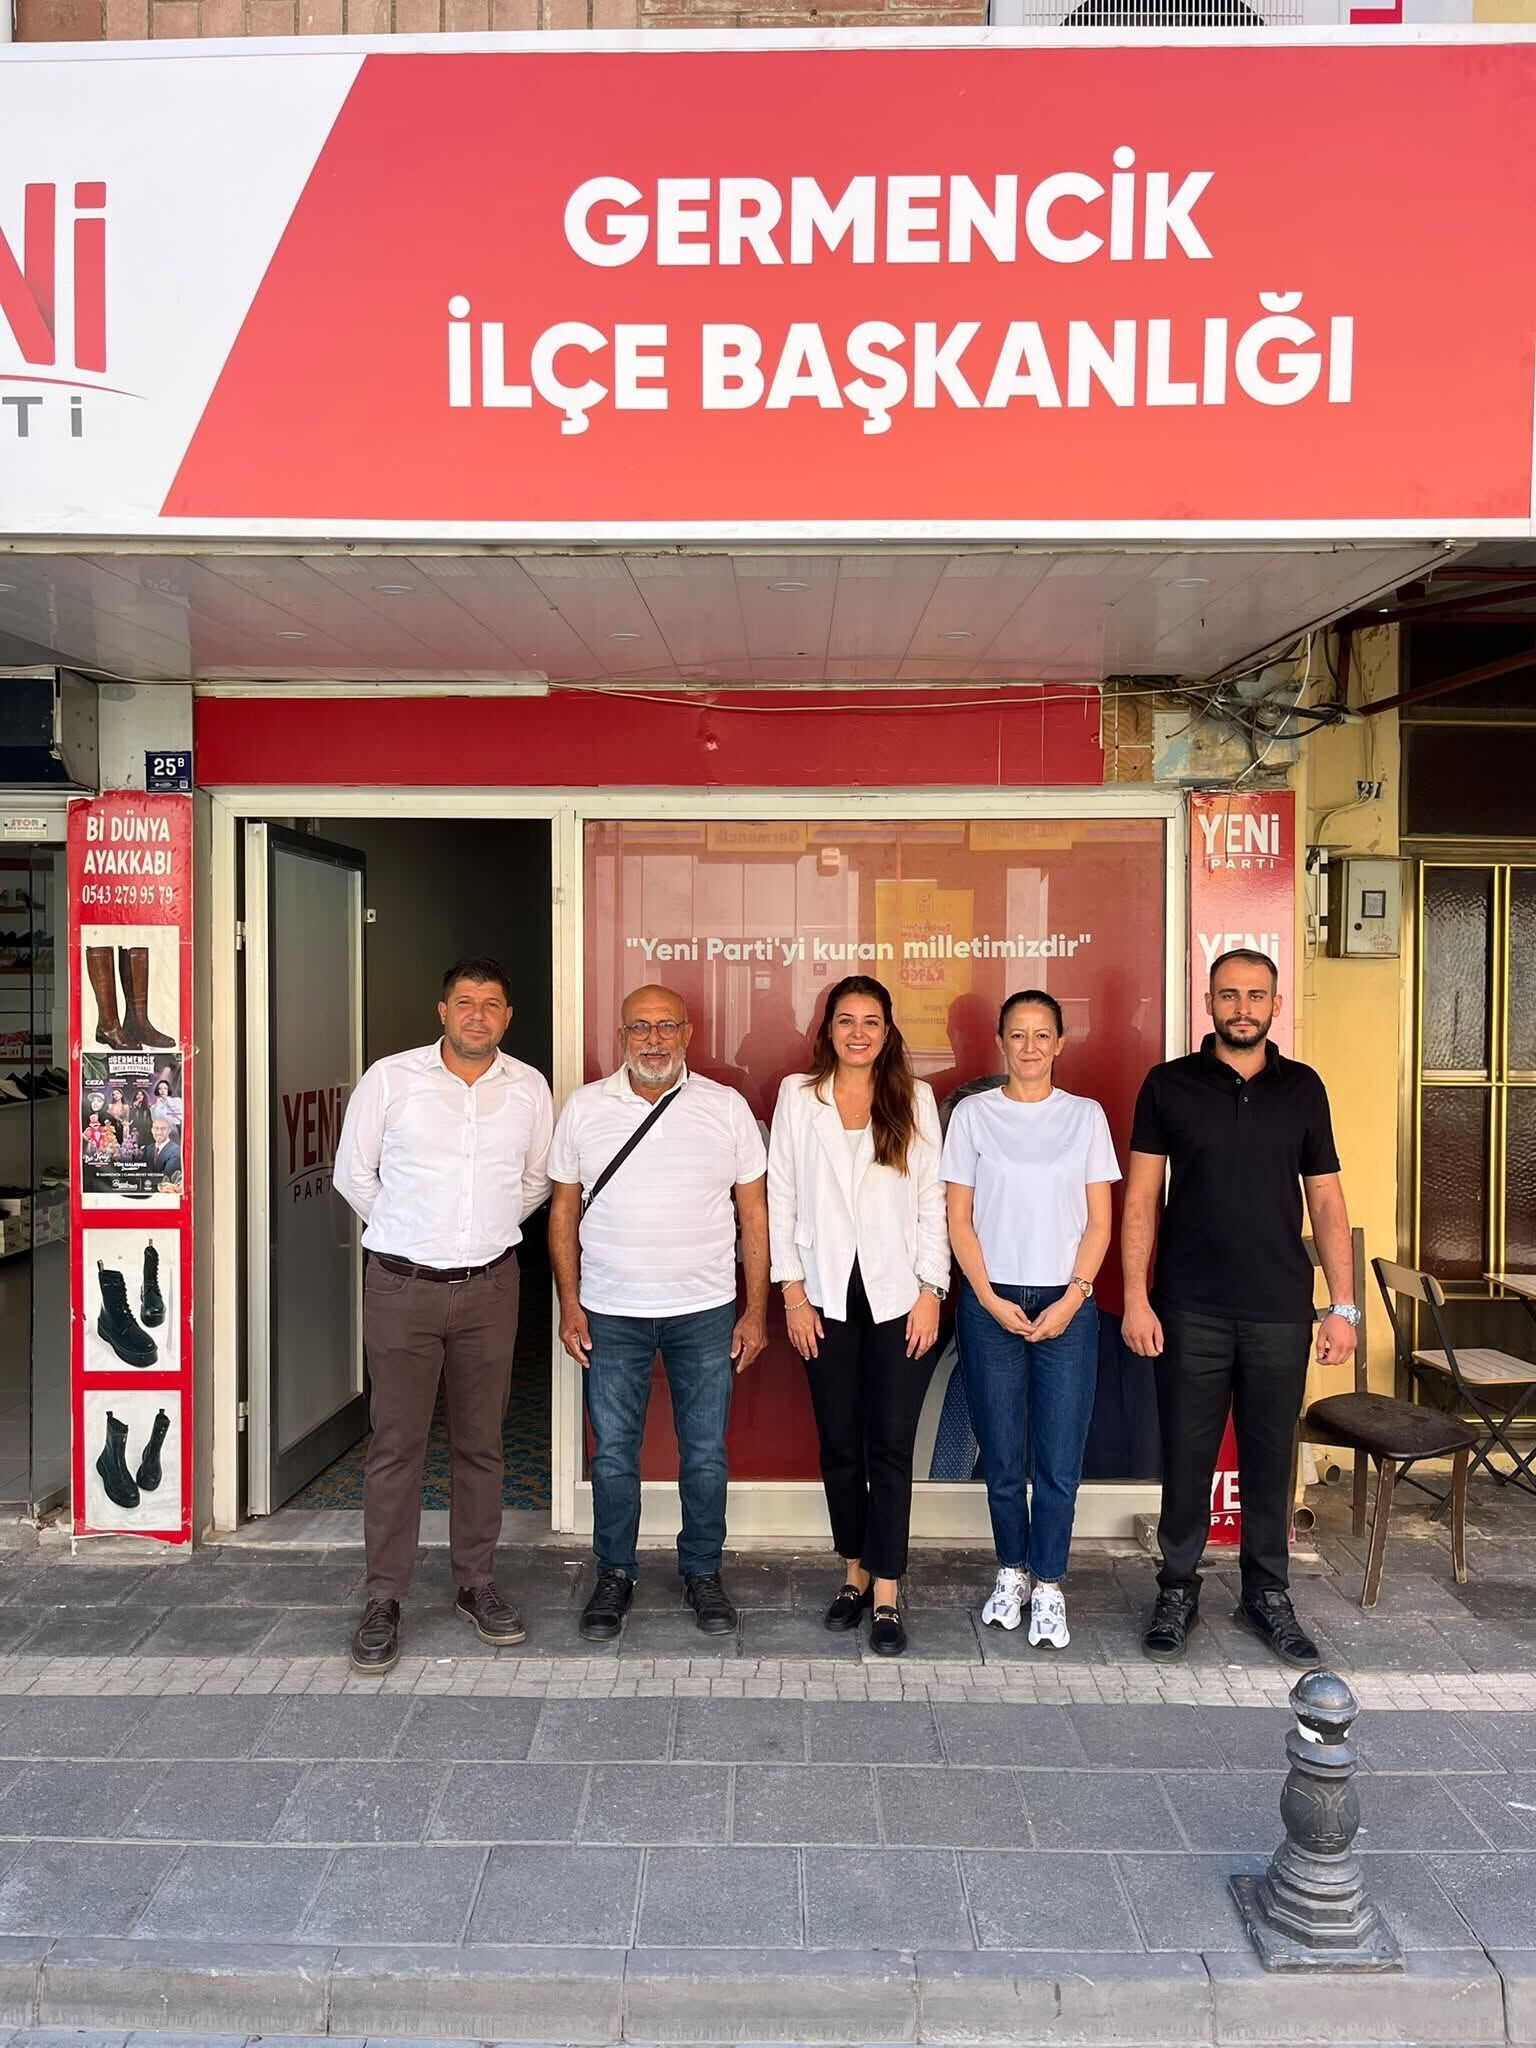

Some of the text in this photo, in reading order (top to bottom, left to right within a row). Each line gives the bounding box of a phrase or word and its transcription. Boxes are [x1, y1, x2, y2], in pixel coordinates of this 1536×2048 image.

[563, 145, 1215, 268] GERMENCİK
[448, 291, 1354, 436] İLÇE BAŞKANLIĞI
[86, 809, 170, 842] Bİ DÜNYA
[83, 850, 172, 876] AYAKKABI
[82, 884, 174, 905] 0543 279 95 79
[626, 933, 1092, 968] "Yeni Parti'yi kuran milletimizdir"
[293, 1174, 334, 1204] PART
[1210, 1470, 1241, 1512] YE
